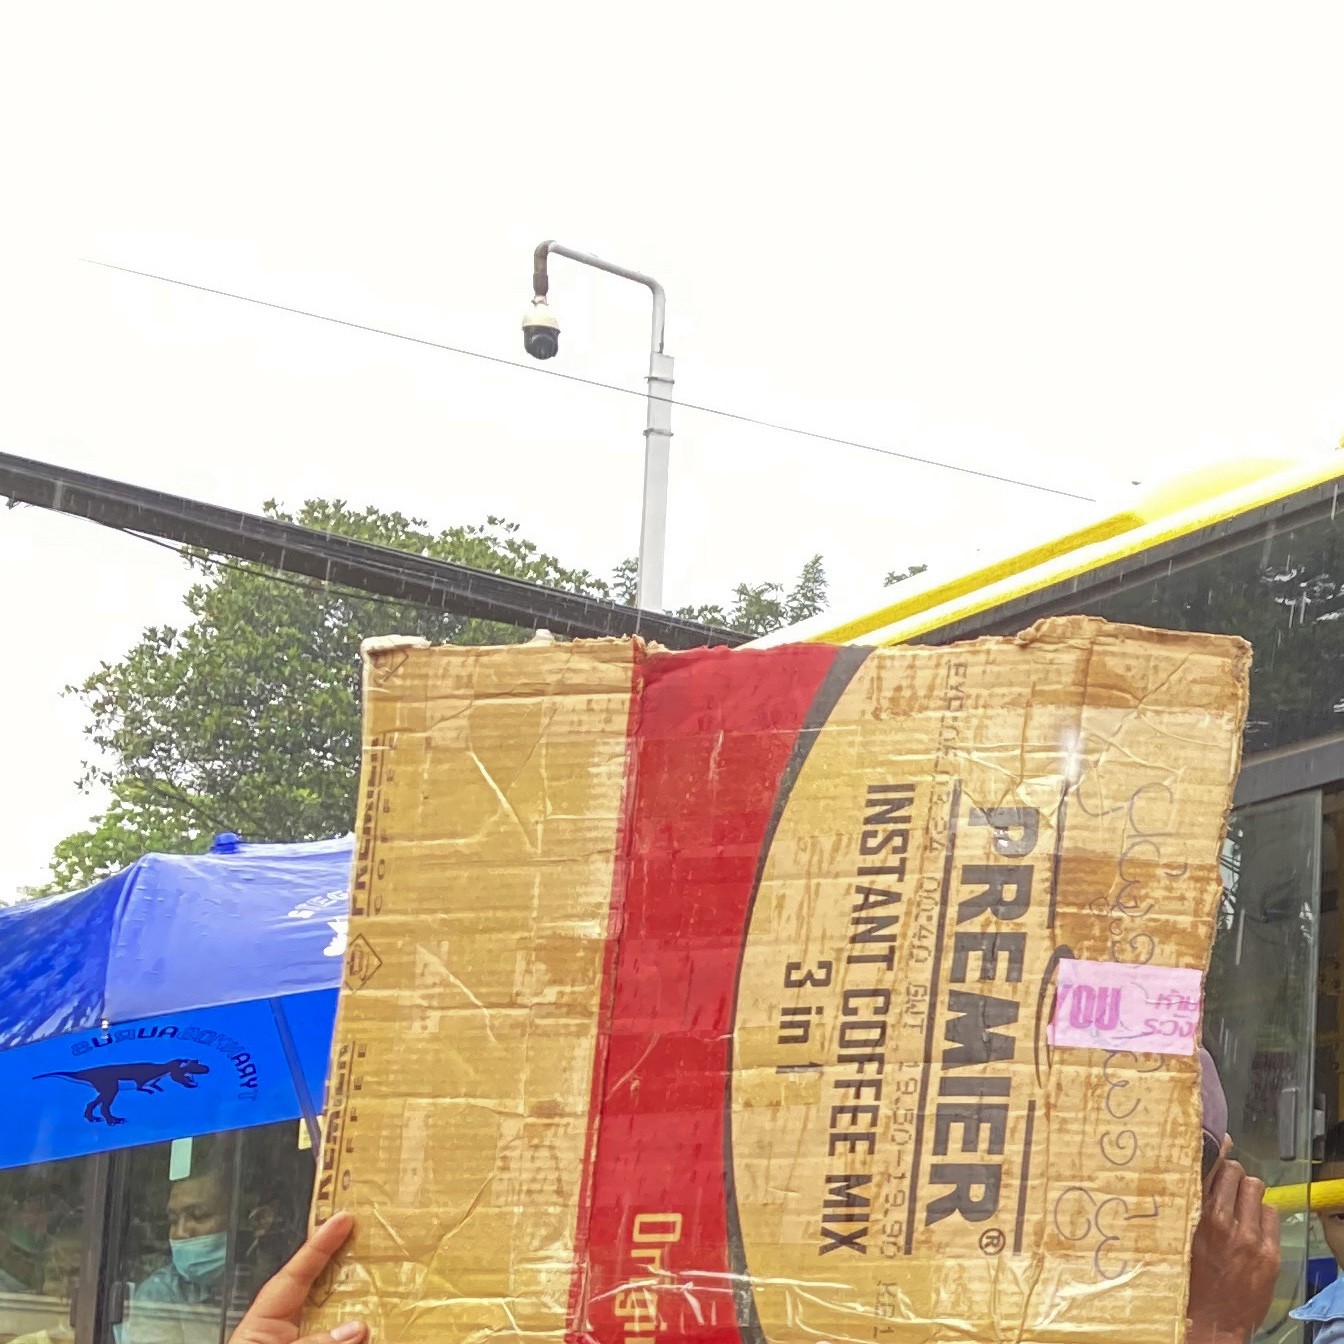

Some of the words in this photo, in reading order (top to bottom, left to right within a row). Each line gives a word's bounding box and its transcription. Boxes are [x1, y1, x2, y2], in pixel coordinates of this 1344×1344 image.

[845, 783, 914, 974] INSTANT
[784, 958, 834, 988] 3
[777, 1005, 827, 1048] in
[776, 1061, 819, 1076] 1
[829, 988, 891, 1160] COFFEE
[818, 1173, 871, 1256] MIX
